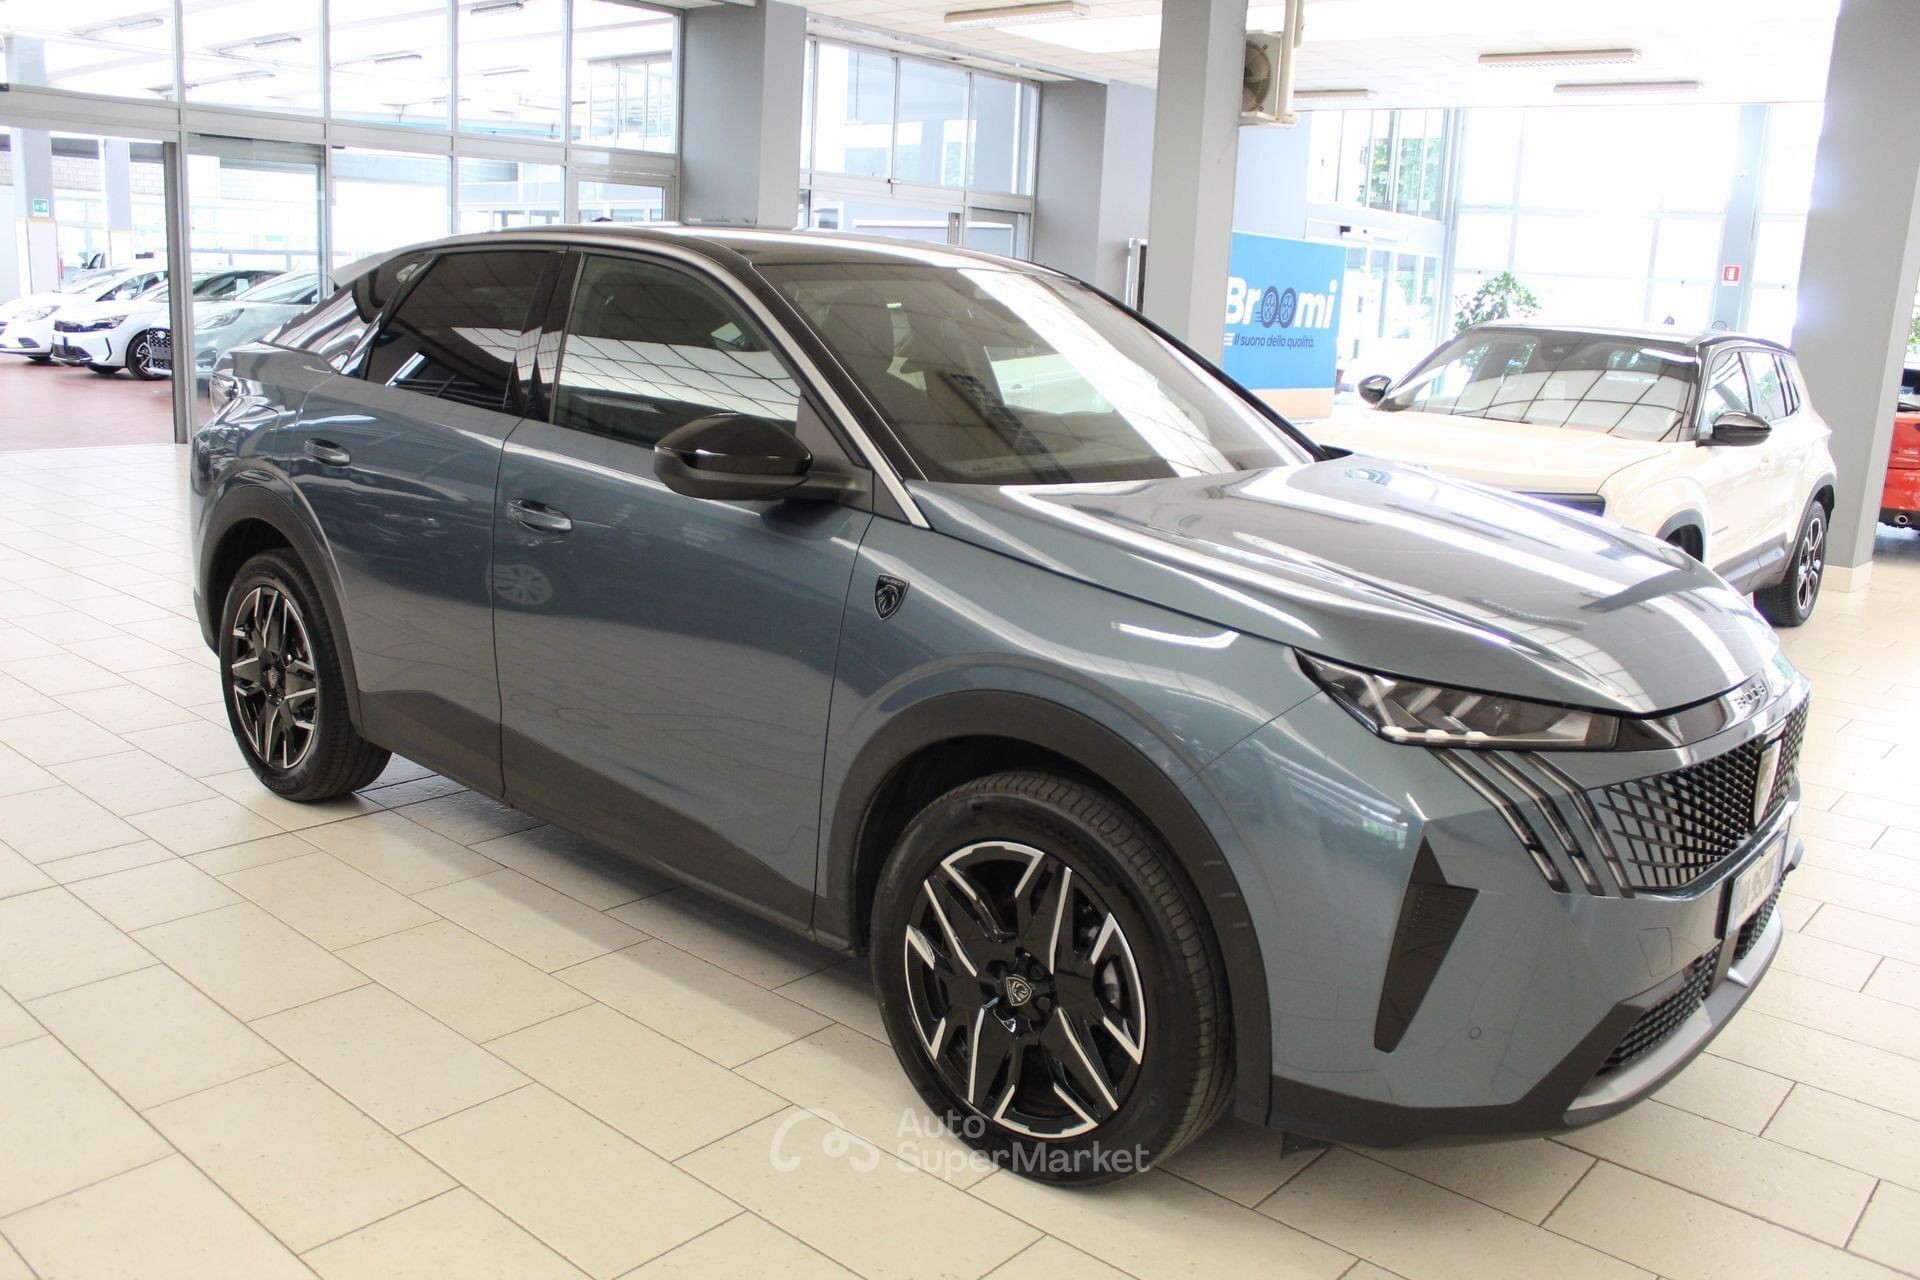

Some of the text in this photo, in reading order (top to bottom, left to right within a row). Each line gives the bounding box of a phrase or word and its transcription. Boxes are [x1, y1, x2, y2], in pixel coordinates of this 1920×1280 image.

[1224, 276, 1338, 329] Broomi
[1234, 333, 1240, 346] Il
[1240, 336, 1265, 347] suono
[1267, 334, 1286, 348] della
